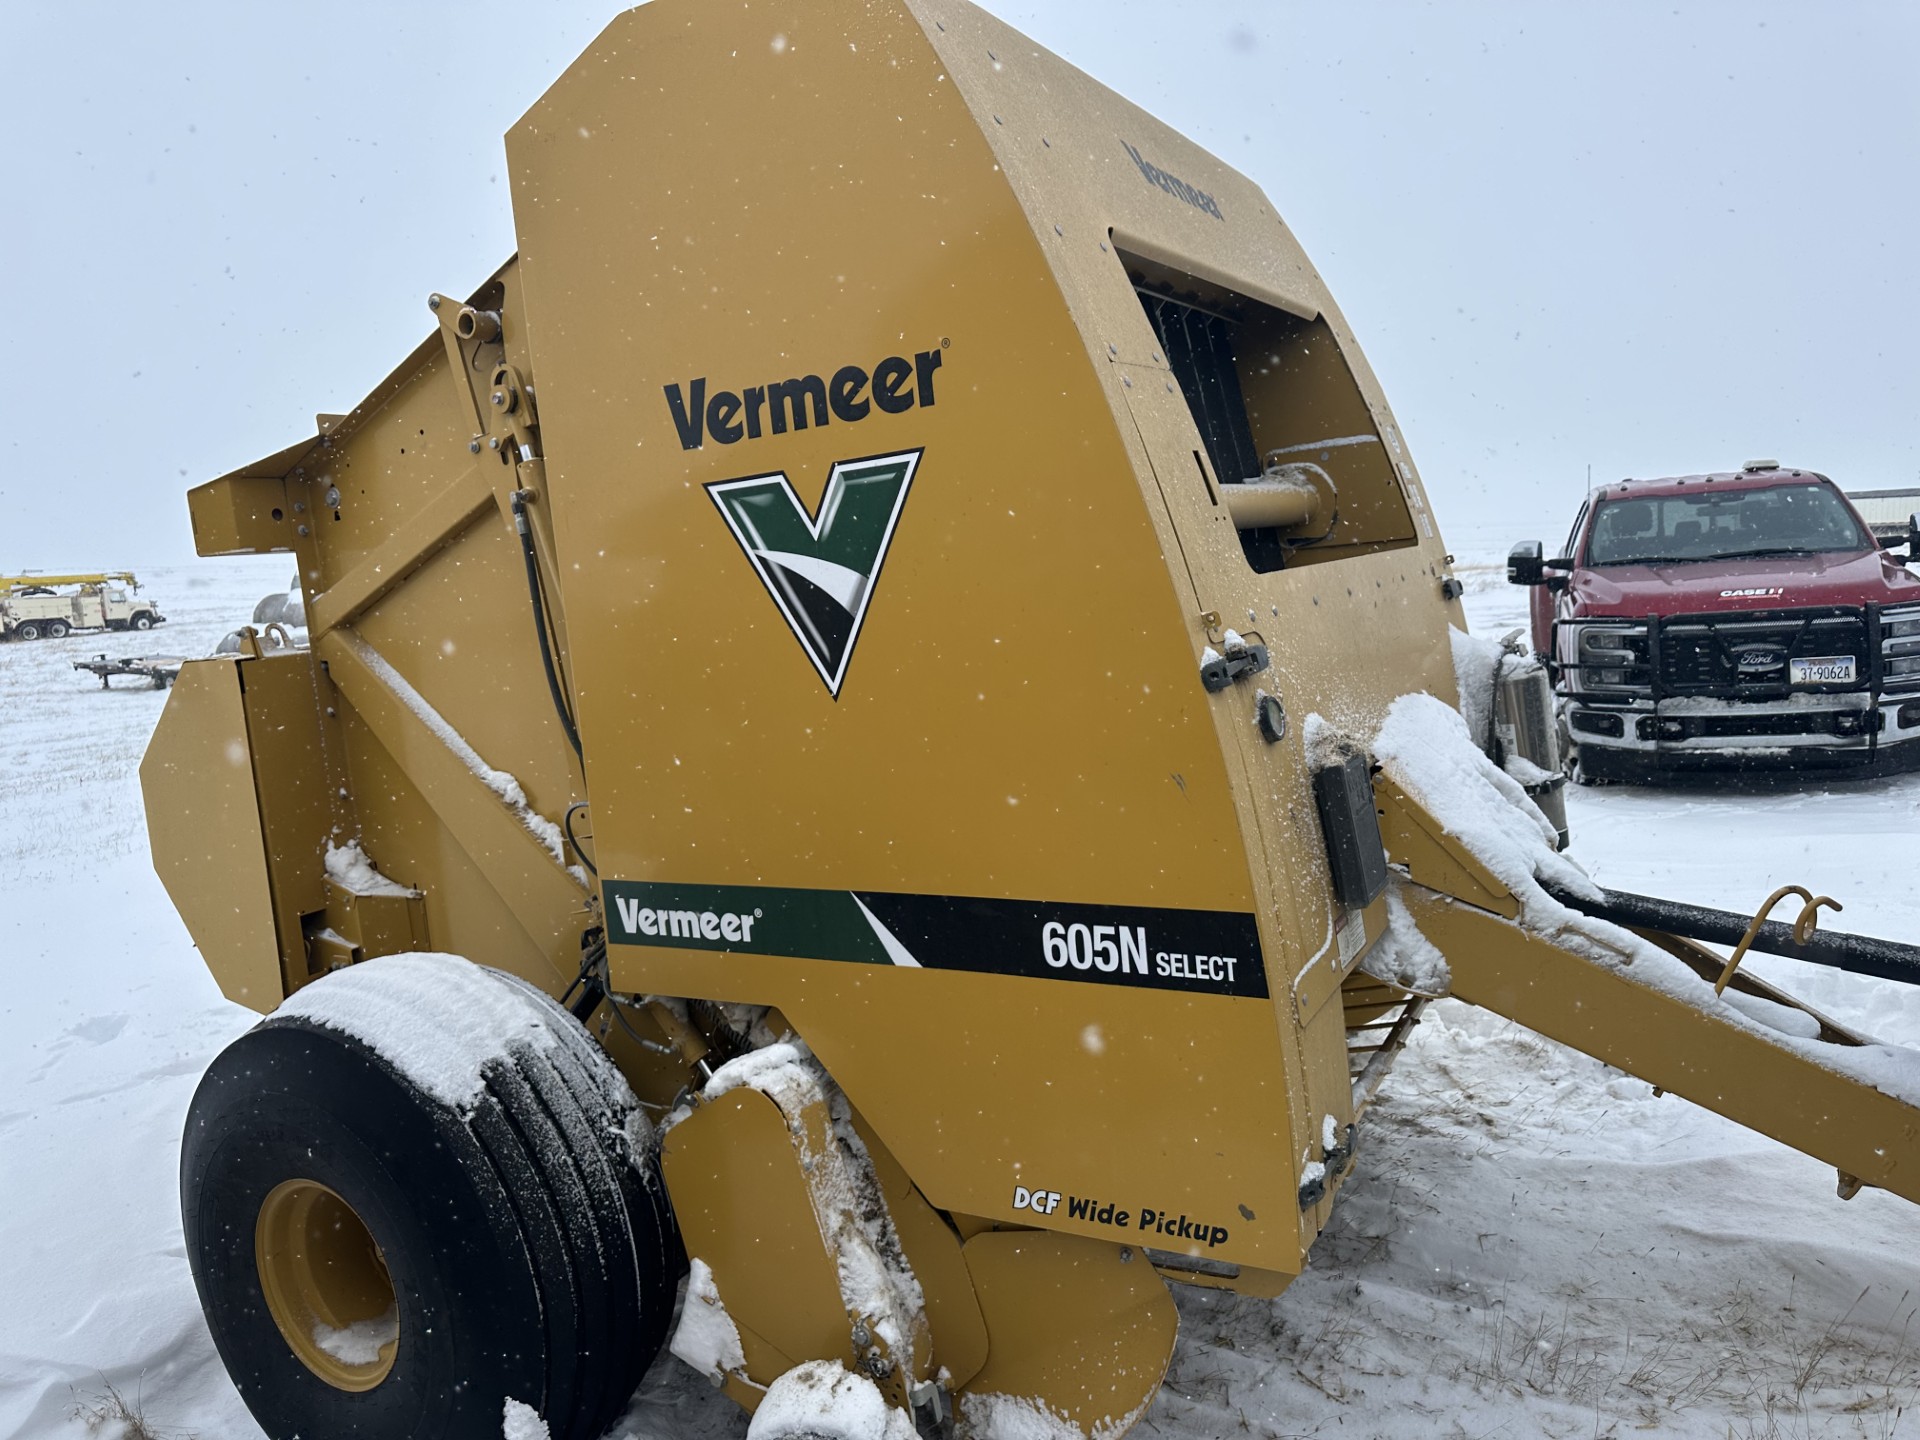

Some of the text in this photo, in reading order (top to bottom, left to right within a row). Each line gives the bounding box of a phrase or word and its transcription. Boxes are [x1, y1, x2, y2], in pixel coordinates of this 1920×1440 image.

[1120, 139, 1225, 222] Vermeer
[1720, 588, 1767, 597] CASE
[1740, 651, 1773, 664] Ford
[1042, 921, 1237, 982] 605N SELECT
[1012, 1185, 1229, 1248] DCF Wide Pickup
